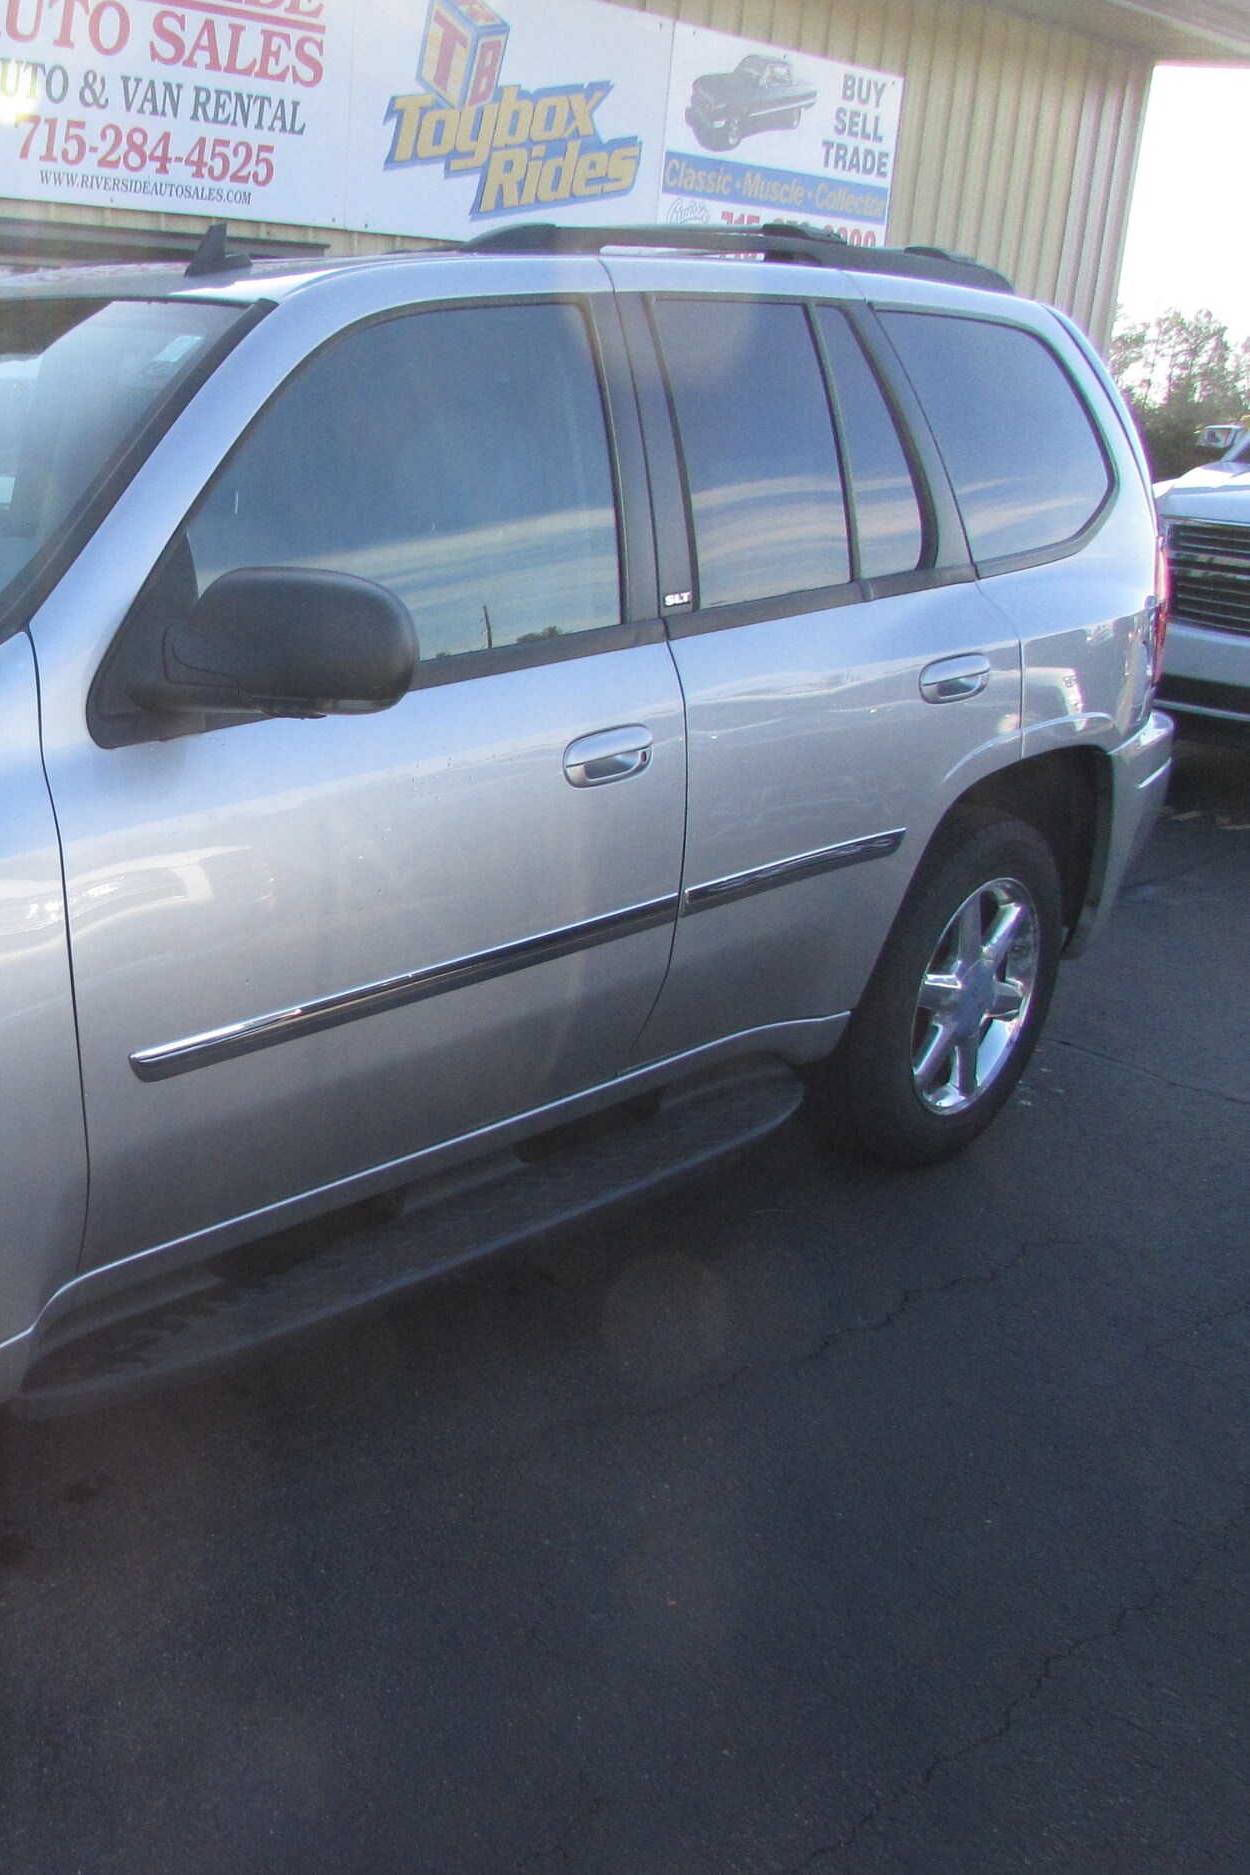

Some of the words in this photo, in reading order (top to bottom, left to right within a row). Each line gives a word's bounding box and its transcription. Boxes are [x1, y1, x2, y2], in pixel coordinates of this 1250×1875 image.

[149, 10, 324, 88] SALES
[79, 69, 110, 110] &
[119, 75, 183, 120] VAN
[190, 85, 306, 136] RENTAL
[842, 73, 887, 109] BUY
[14, 113, 276, 187] 715-284-4525
[390, 84, 606, 173] Toybox
[833, 107, 884, 143] SELL
[39, 169, 252, 205] WWW.RIVERSIDEAUTOSALES.COM
[478, 139, 641, 213] Rides
[822, 139, 889, 178] TRADE
[665, 159, 732, 196] Classic
[742, 171, 806, 206] Muscle
[814, 183, 886, 218] Collector
[664, 591, 691, 607] SLT
